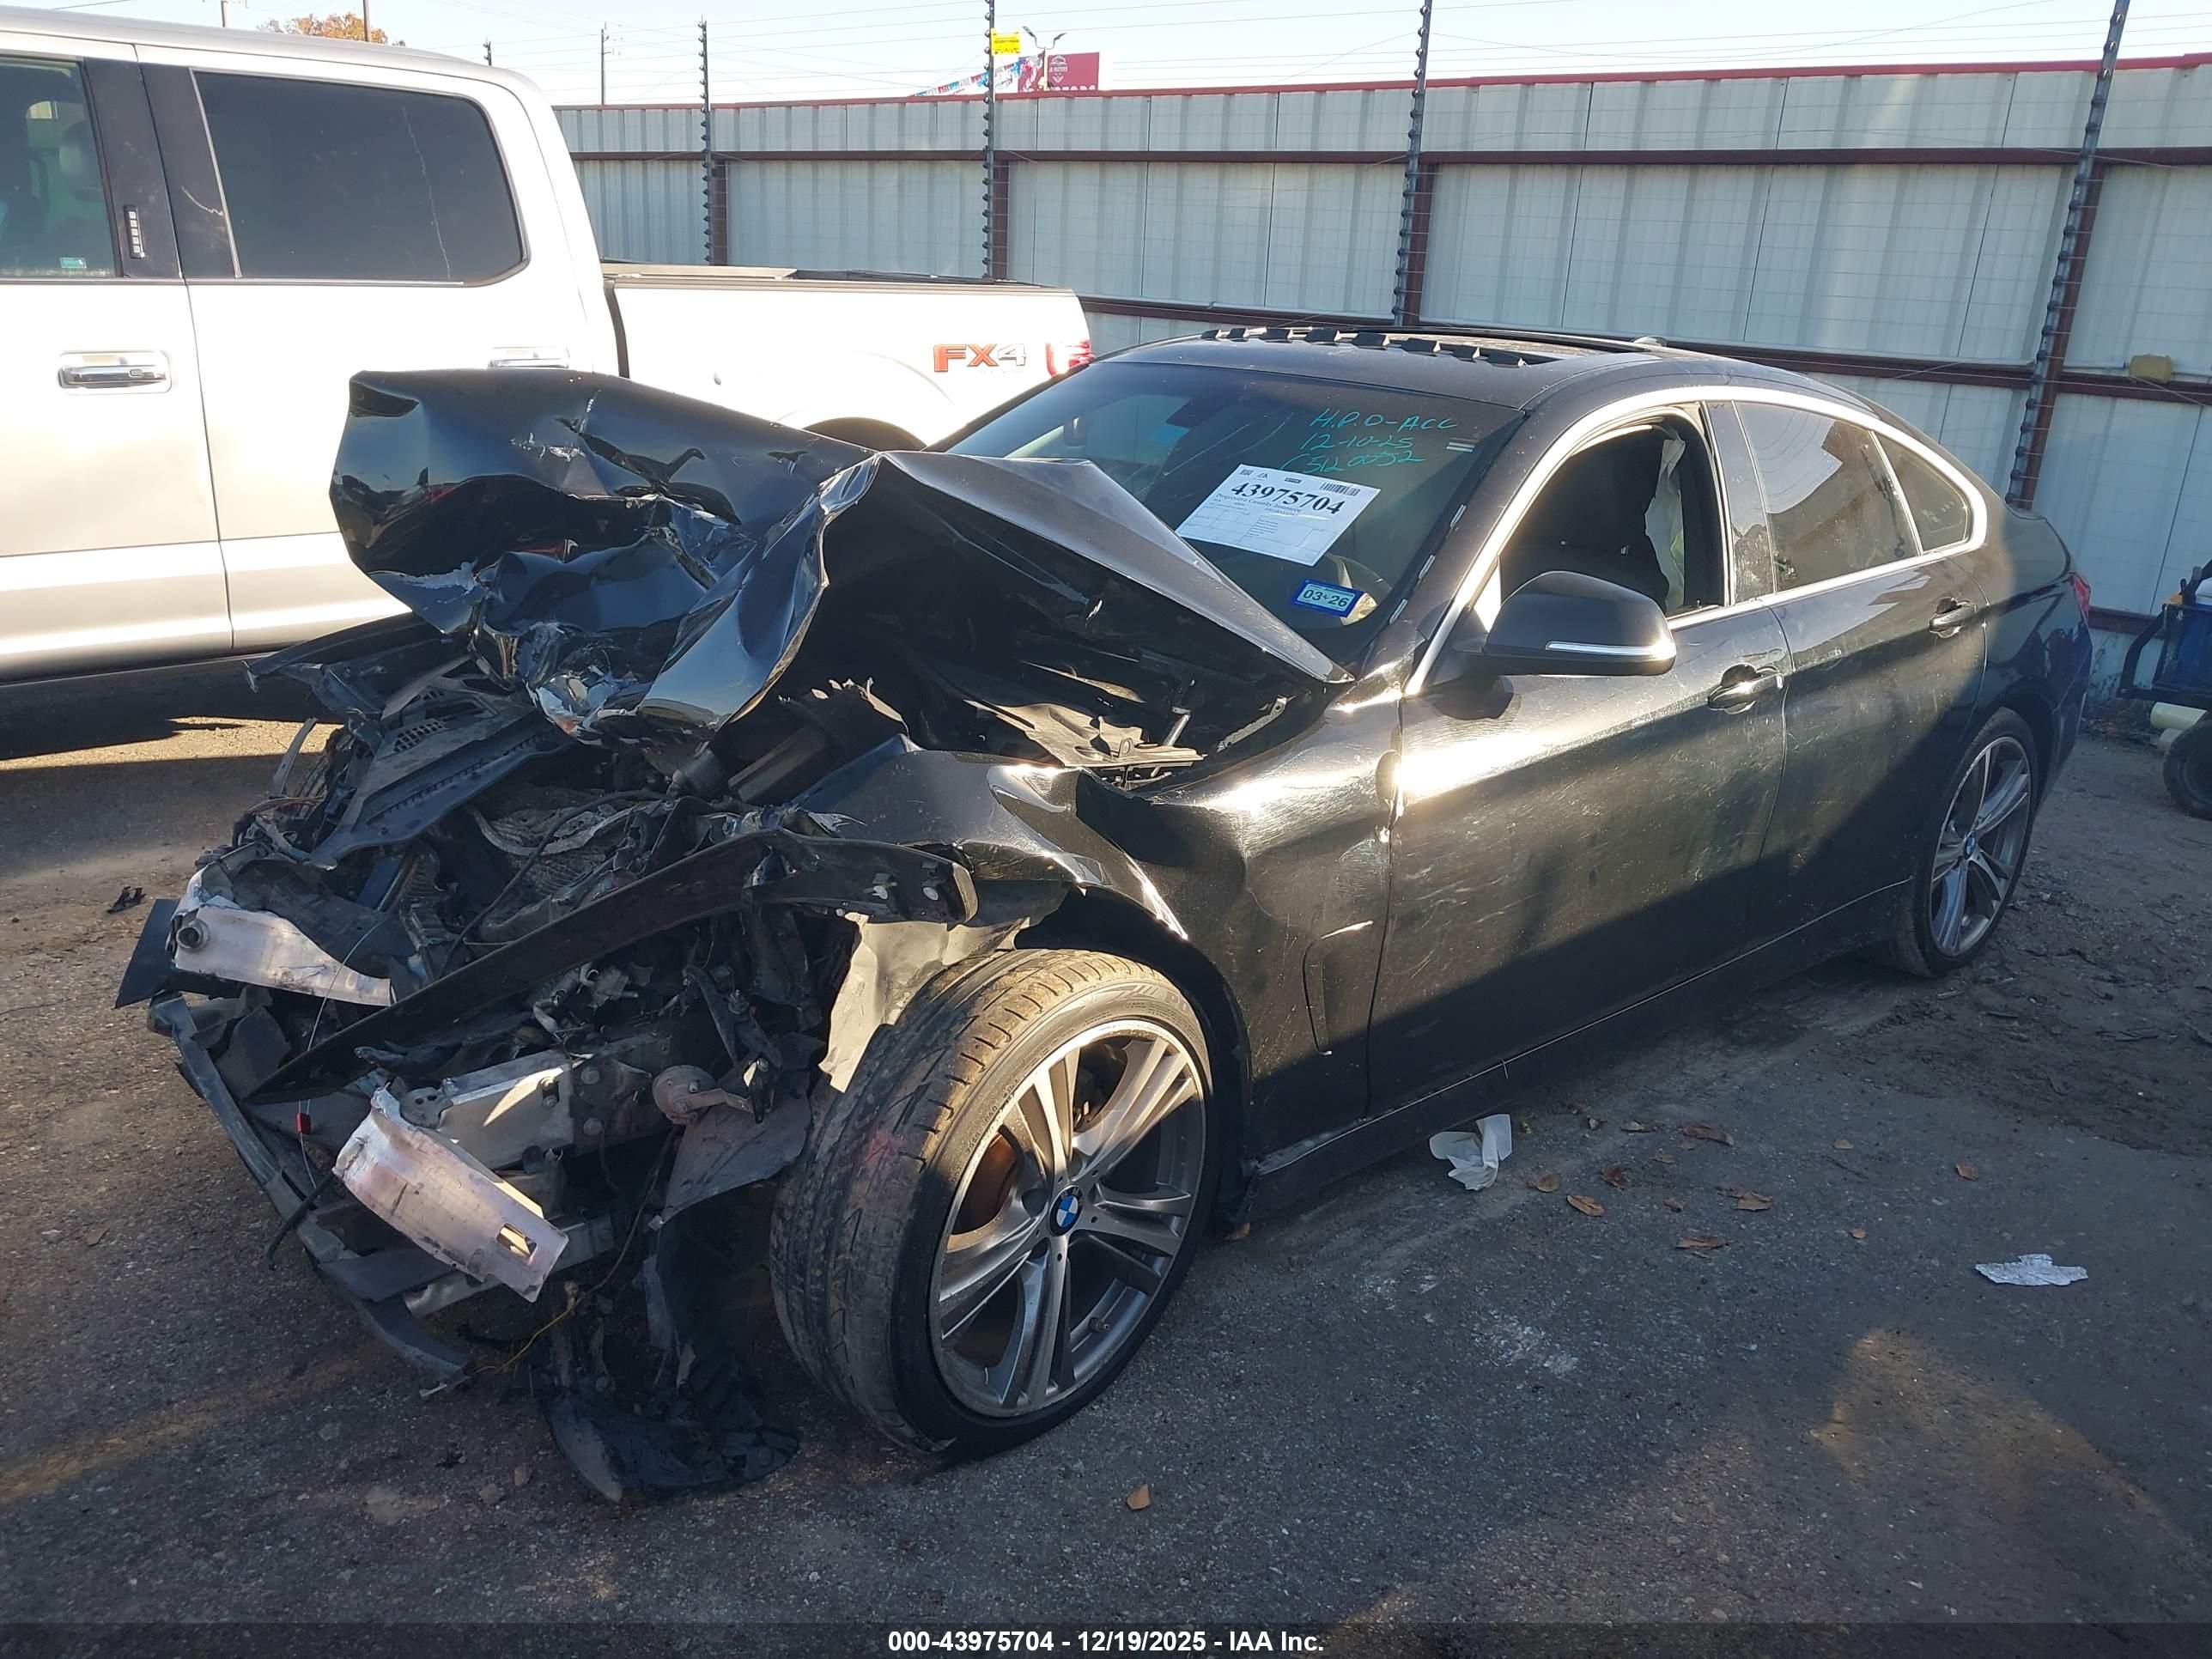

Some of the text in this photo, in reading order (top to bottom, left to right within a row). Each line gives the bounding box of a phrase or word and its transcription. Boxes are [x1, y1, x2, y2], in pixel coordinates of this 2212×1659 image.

[933, 343, 1026, 372] FX4
[1231, 482, 1346, 514] 43975704
[1303, 589, 1322, 601] 03
[1328, 595, 1350, 607] 26
